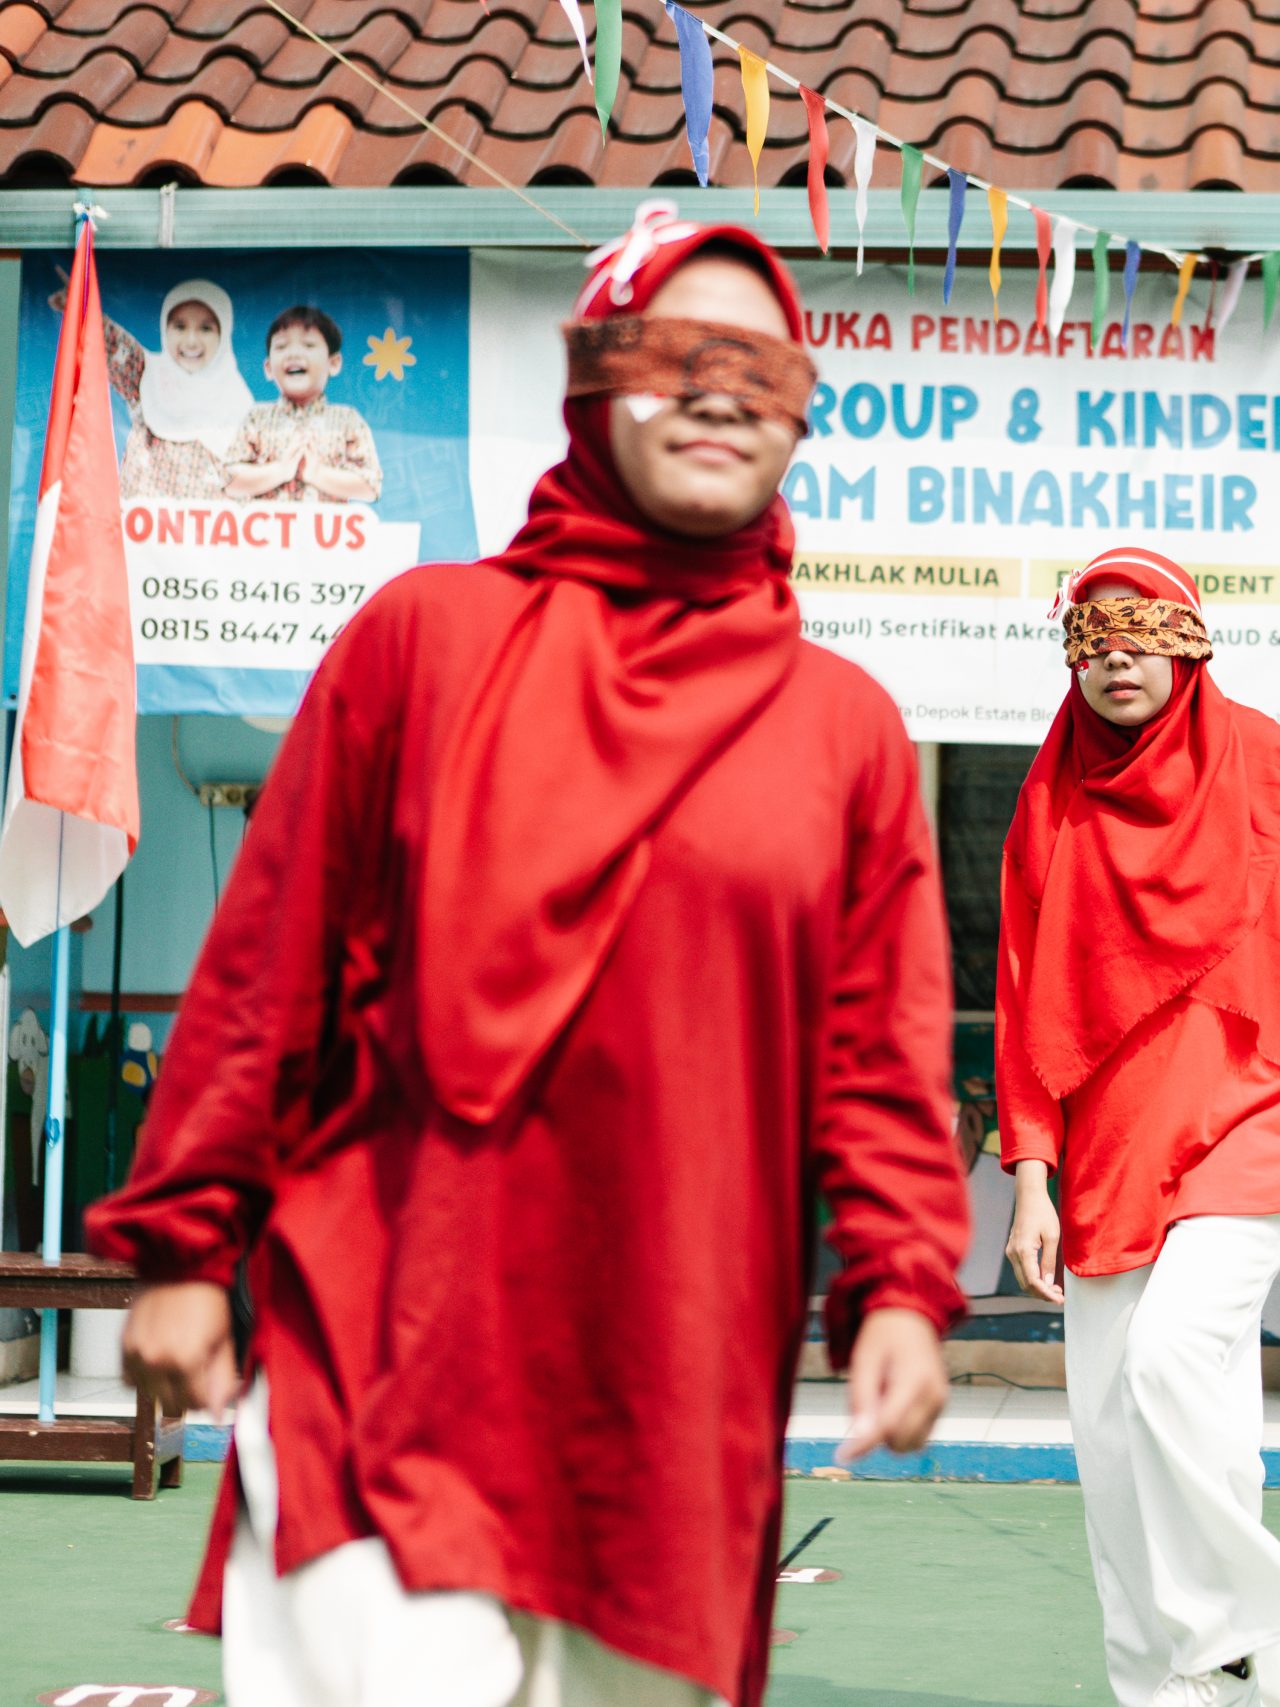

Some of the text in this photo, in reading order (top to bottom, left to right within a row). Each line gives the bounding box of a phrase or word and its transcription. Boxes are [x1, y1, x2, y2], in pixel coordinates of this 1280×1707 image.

[804, 310, 1216, 361] UKA PENDAFTARAN
[807, 382, 979, 441] ROUP
[1006, 388, 1042, 443] &
[781, 461, 1258, 532] AM BINAKHEIR
[125, 507, 366, 551] ONTACT US
[790, 562, 1000, 587] AKHLAK MULIA
[1196, 574, 1274, 594] DENT
[142, 577, 219, 600] 0856
[229, 580, 300, 603] 8416
[141, 618, 209, 641] 0815
[220, 620, 299, 644] 8447
[801, 617, 1066, 642] nggul) Sertifikat Akre
[1211, 629, 1261, 646] AUD
[916, 704, 970, 721] Depok
[974, 706, 1027, 722] Estate
